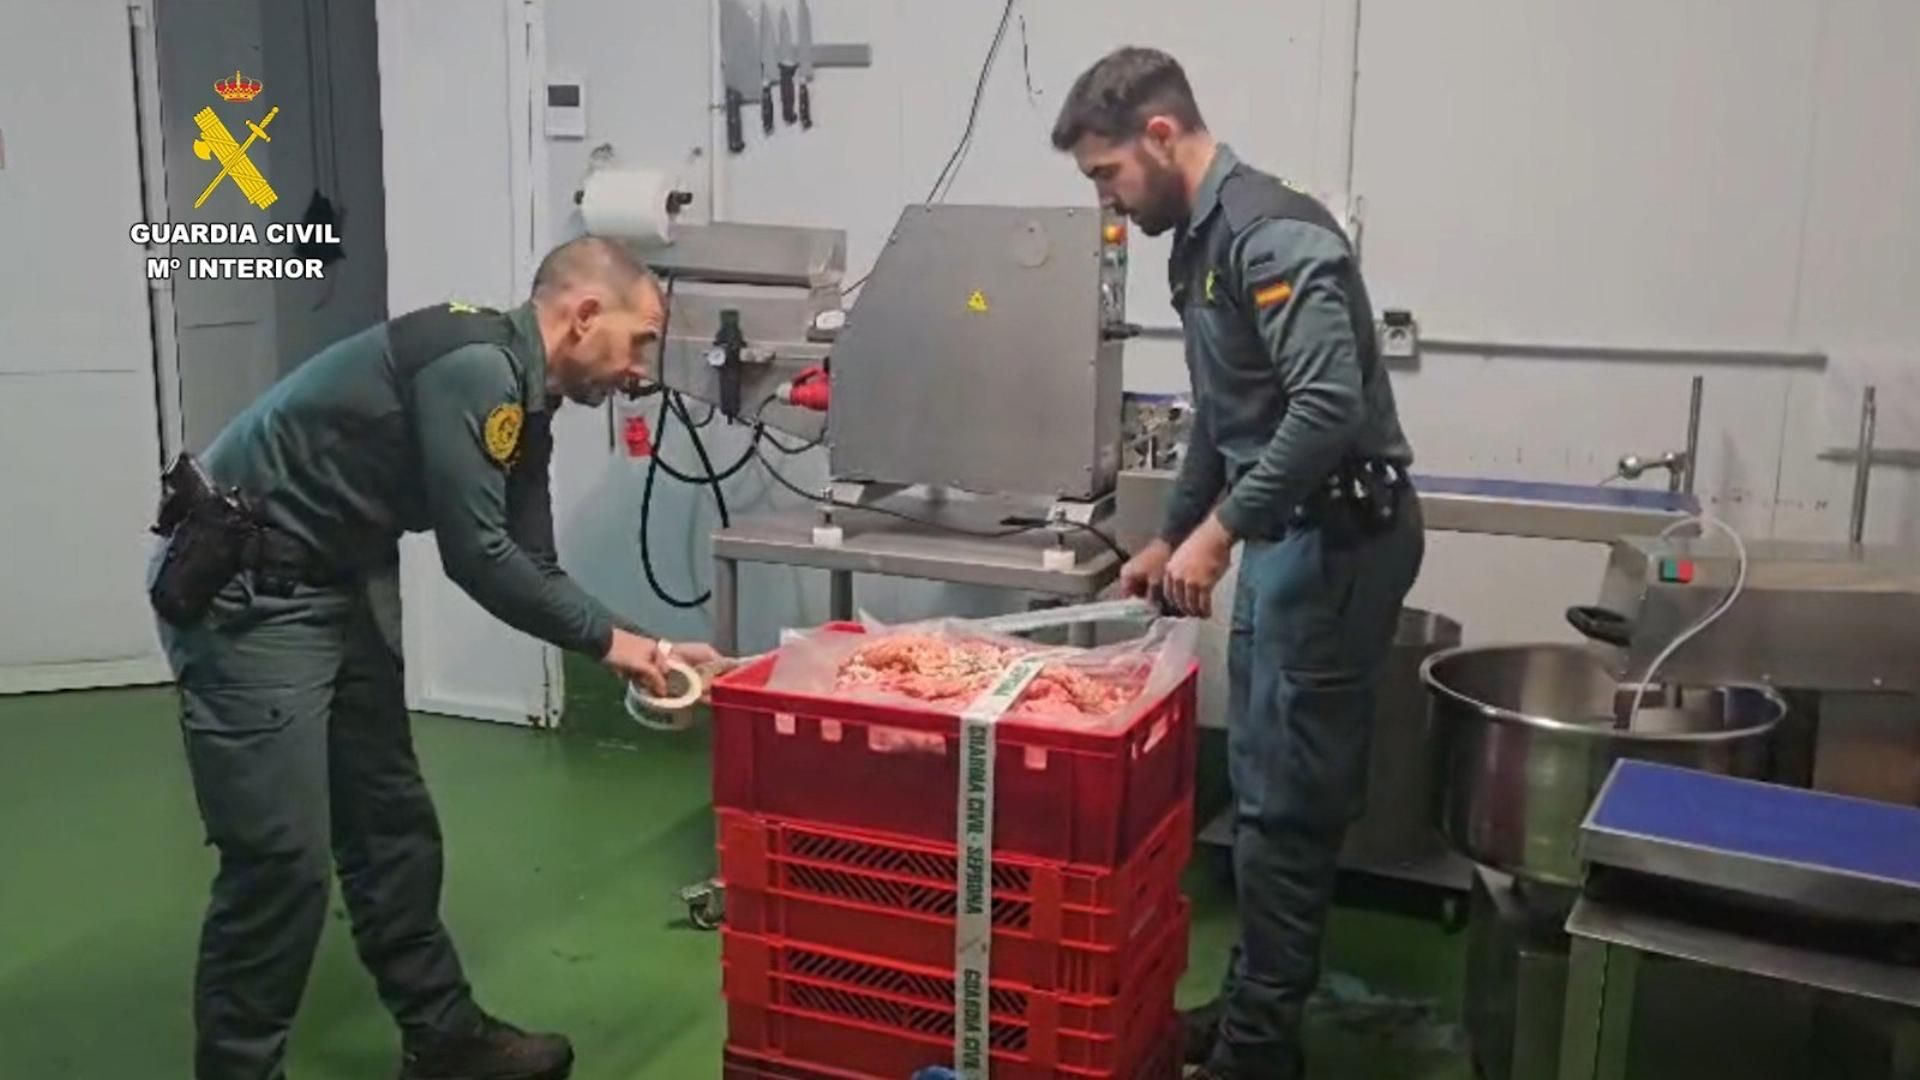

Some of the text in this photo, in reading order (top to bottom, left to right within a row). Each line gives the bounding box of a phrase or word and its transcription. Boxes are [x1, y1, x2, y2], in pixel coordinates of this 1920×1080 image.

[966, 725, 988, 793] GUARDIA
[965, 798, 986, 835] CIVIL
[963, 968, 983, 1070] GUARDIA CIVIL
